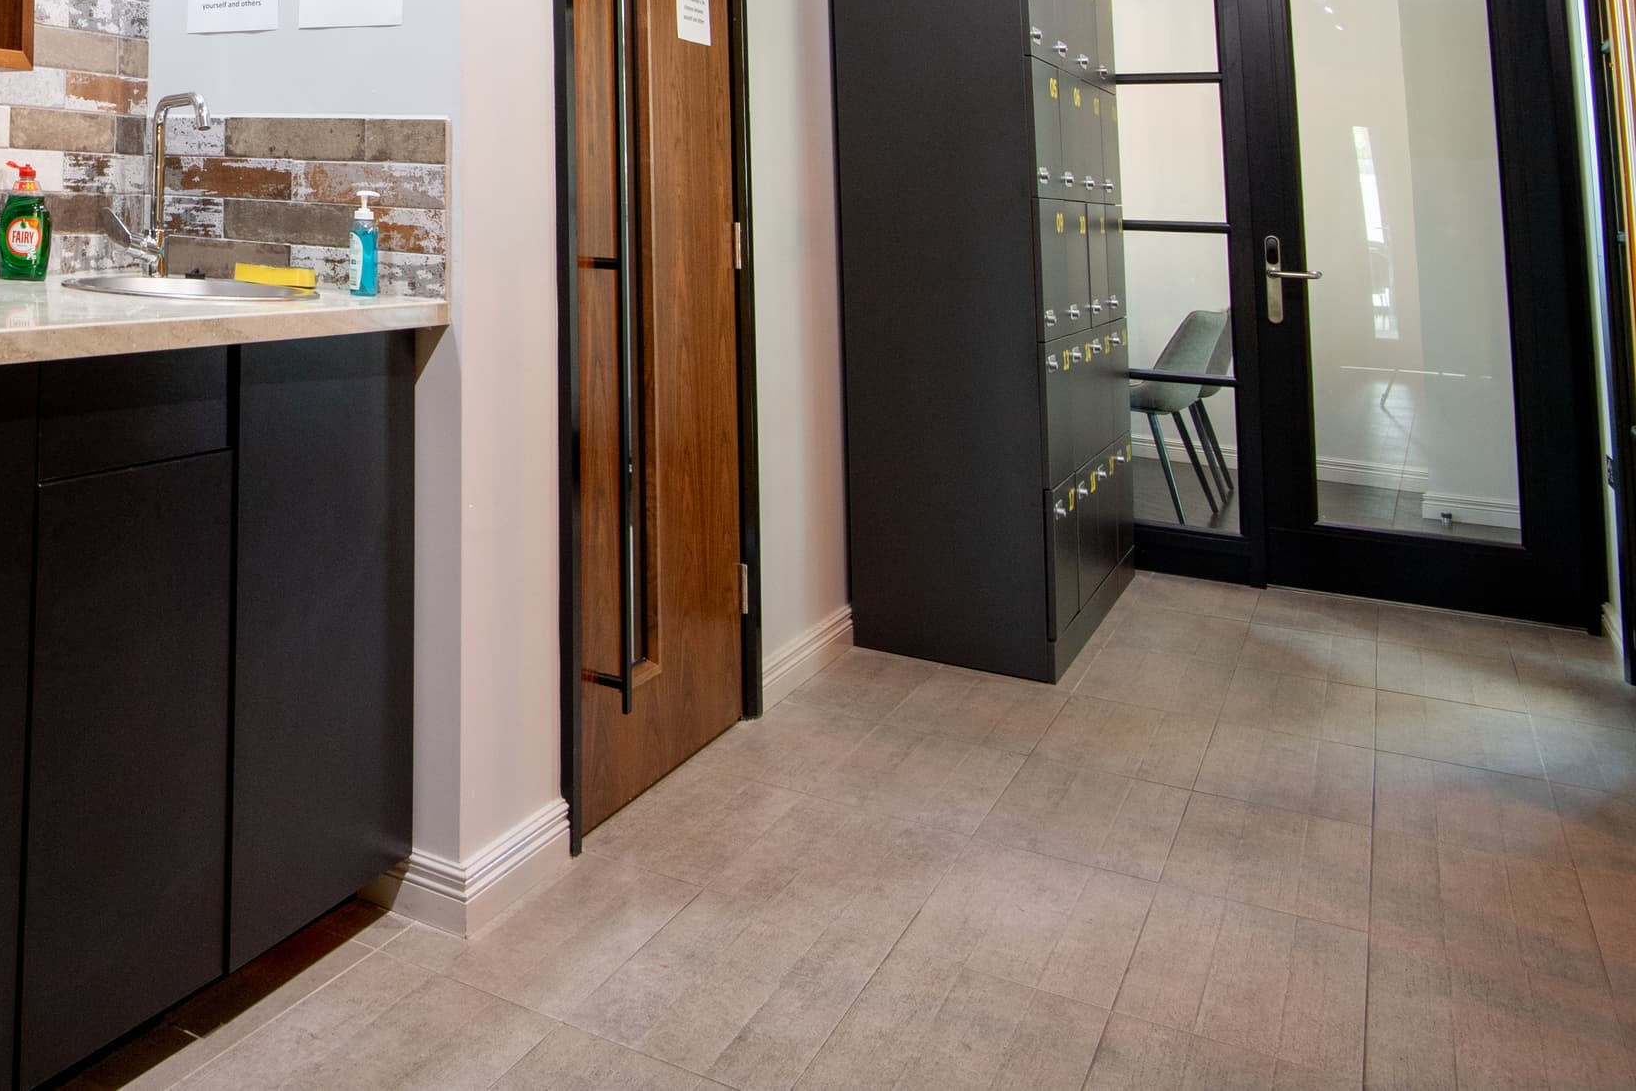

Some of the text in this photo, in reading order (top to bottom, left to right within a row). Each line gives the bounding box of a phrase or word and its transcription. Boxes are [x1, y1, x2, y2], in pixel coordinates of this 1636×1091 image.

[202, 0, 262, 10] yourself and others
[12, 230, 35, 245] FAIRY
